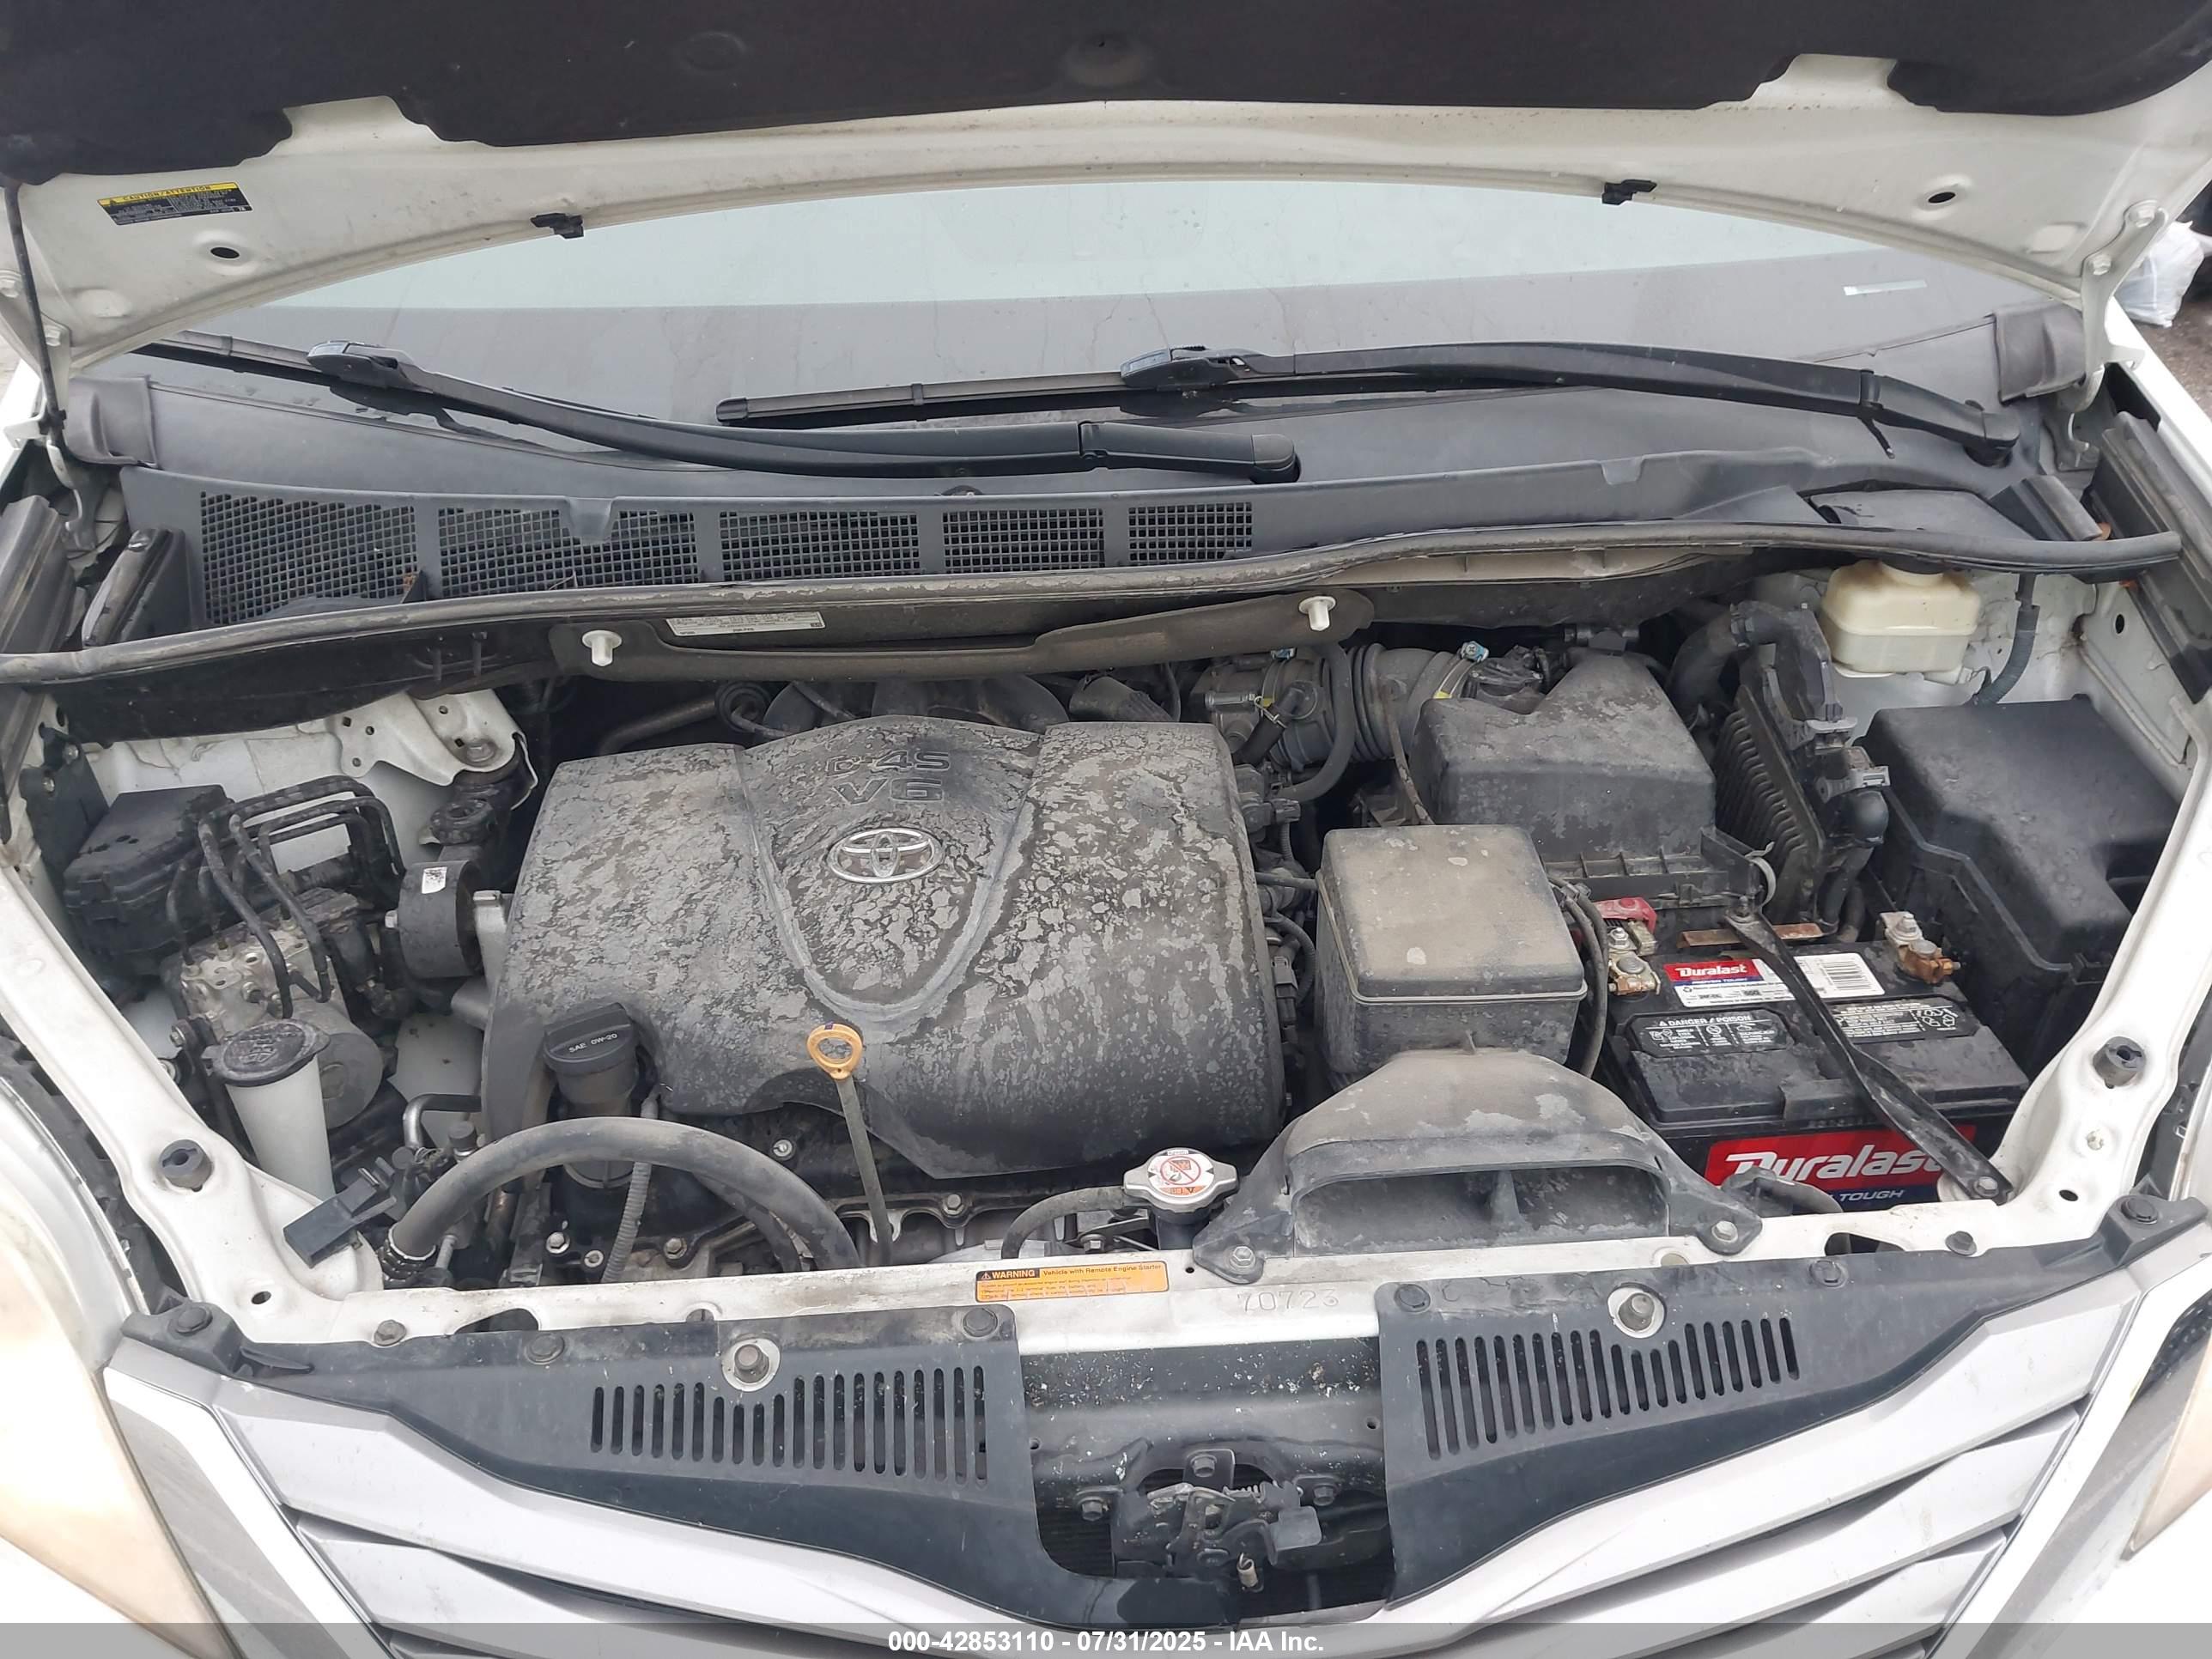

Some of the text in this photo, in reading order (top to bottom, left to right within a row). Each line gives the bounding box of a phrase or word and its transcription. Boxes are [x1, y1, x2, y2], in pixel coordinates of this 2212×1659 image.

[832, 777, 945, 805] V6
[1674, 963, 1748, 977] Duralast
[1668, 1018, 1708, 1026] DANGER
[568, 1042, 586, 1053] SAE
[1839, 1189, 1905, 1202] TOUGH
[992, 1270, 1036, 1279] WARNING
[1237, 1289, 1340, 1313] 70723
